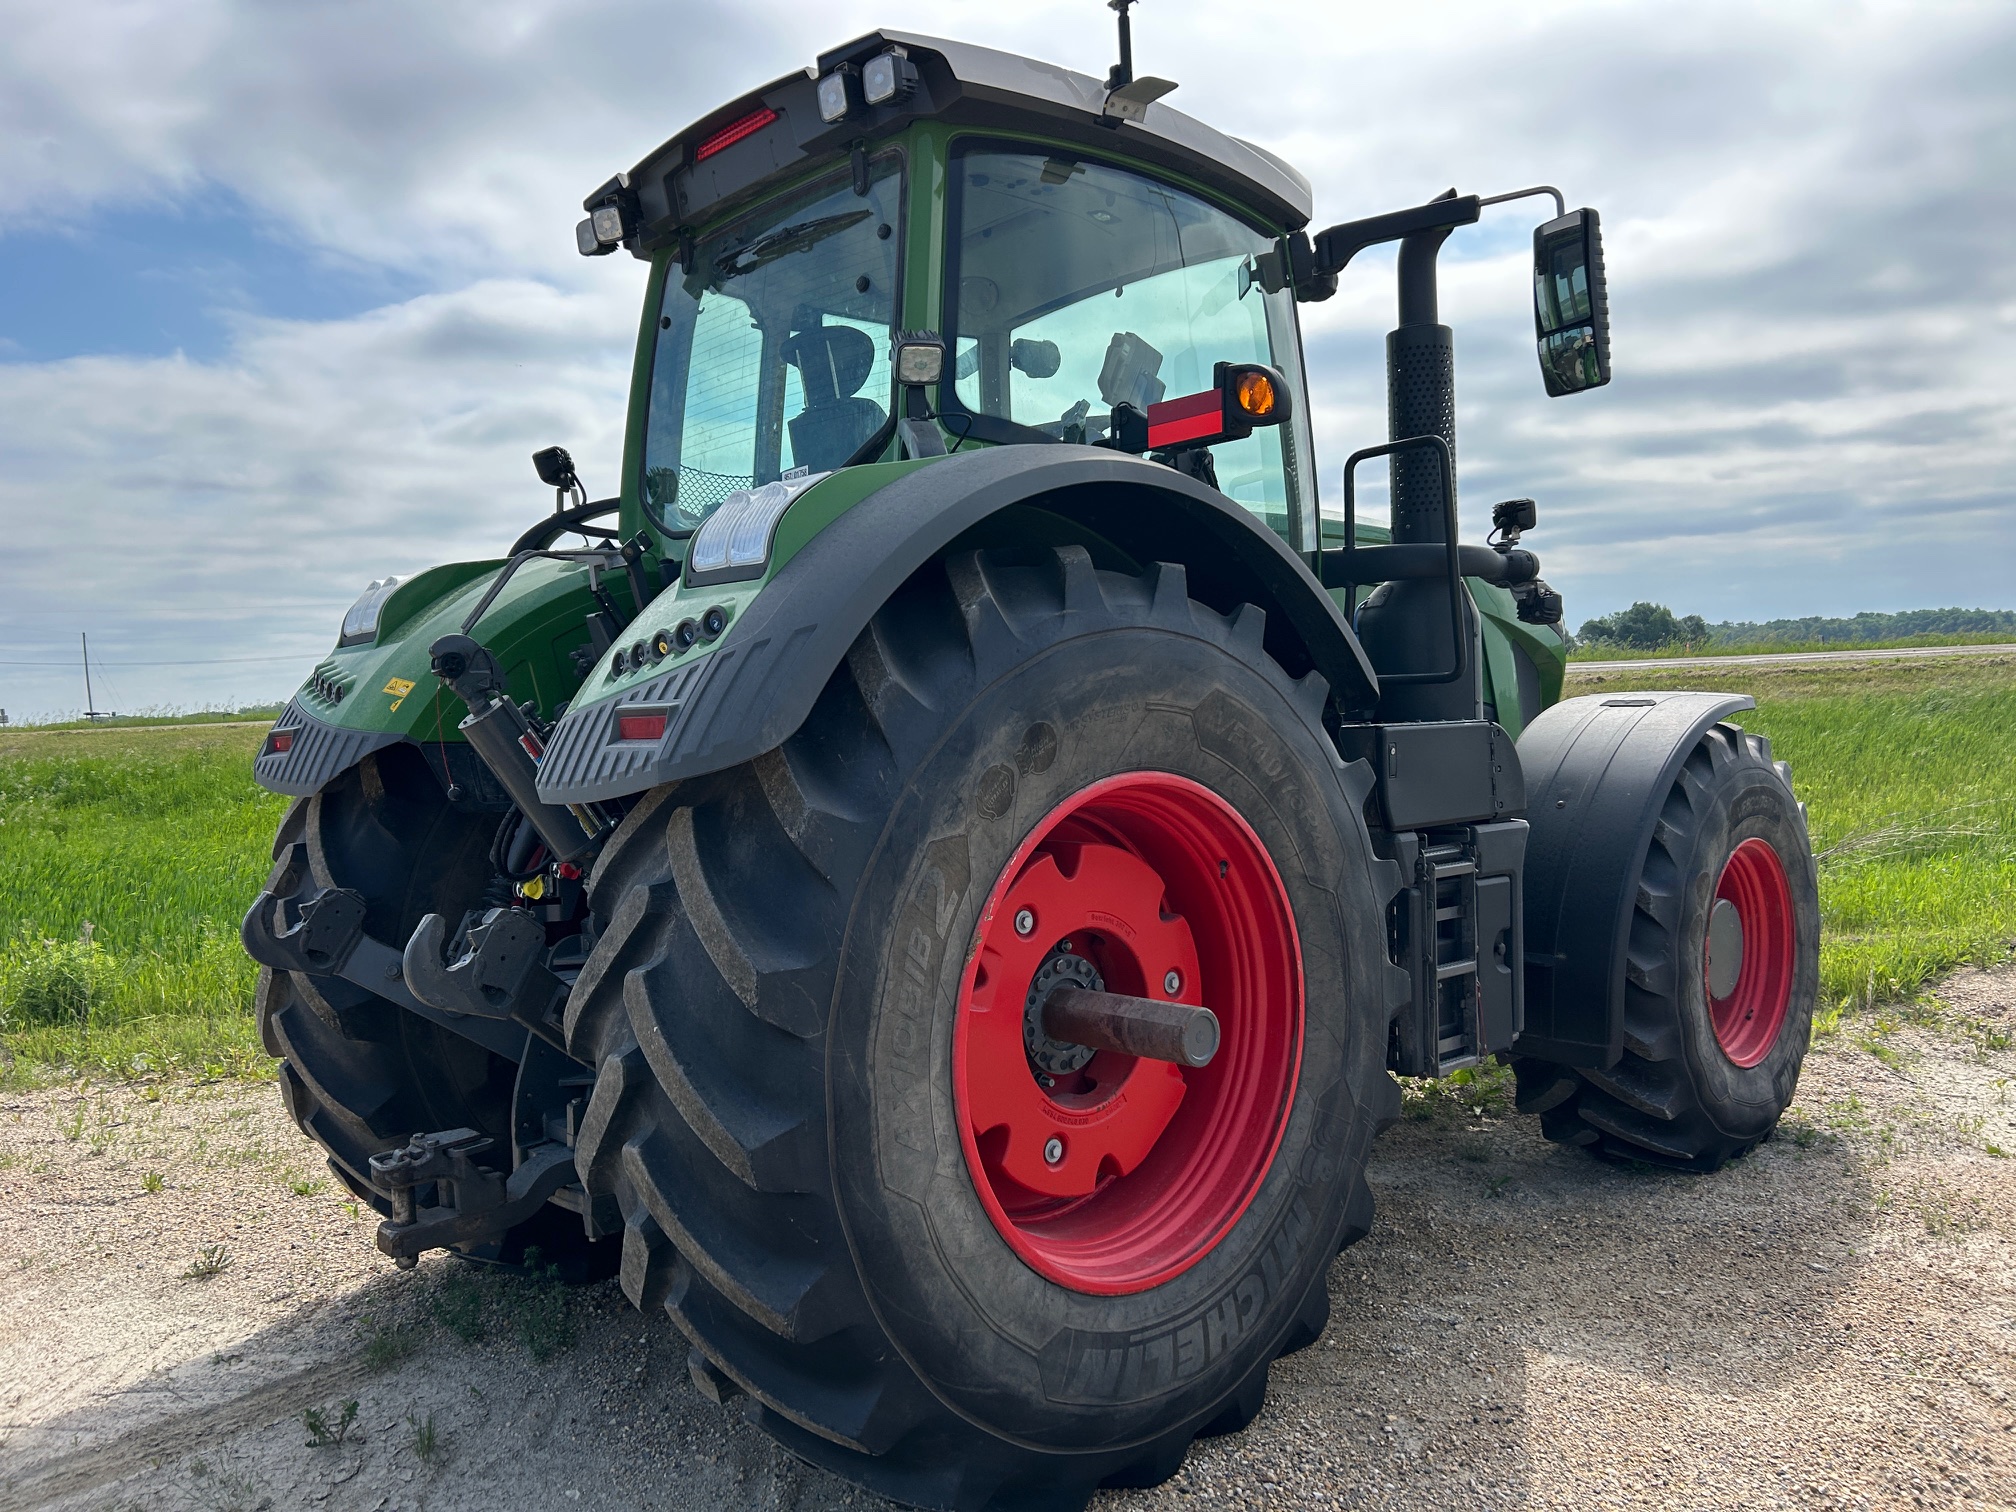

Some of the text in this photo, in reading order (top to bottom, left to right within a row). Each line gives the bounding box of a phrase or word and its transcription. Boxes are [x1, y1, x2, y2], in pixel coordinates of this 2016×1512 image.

[890, 866, 959, 1152] AXIOBIB 2
[1063, 1199, 1315, 1398] MICHELIN
